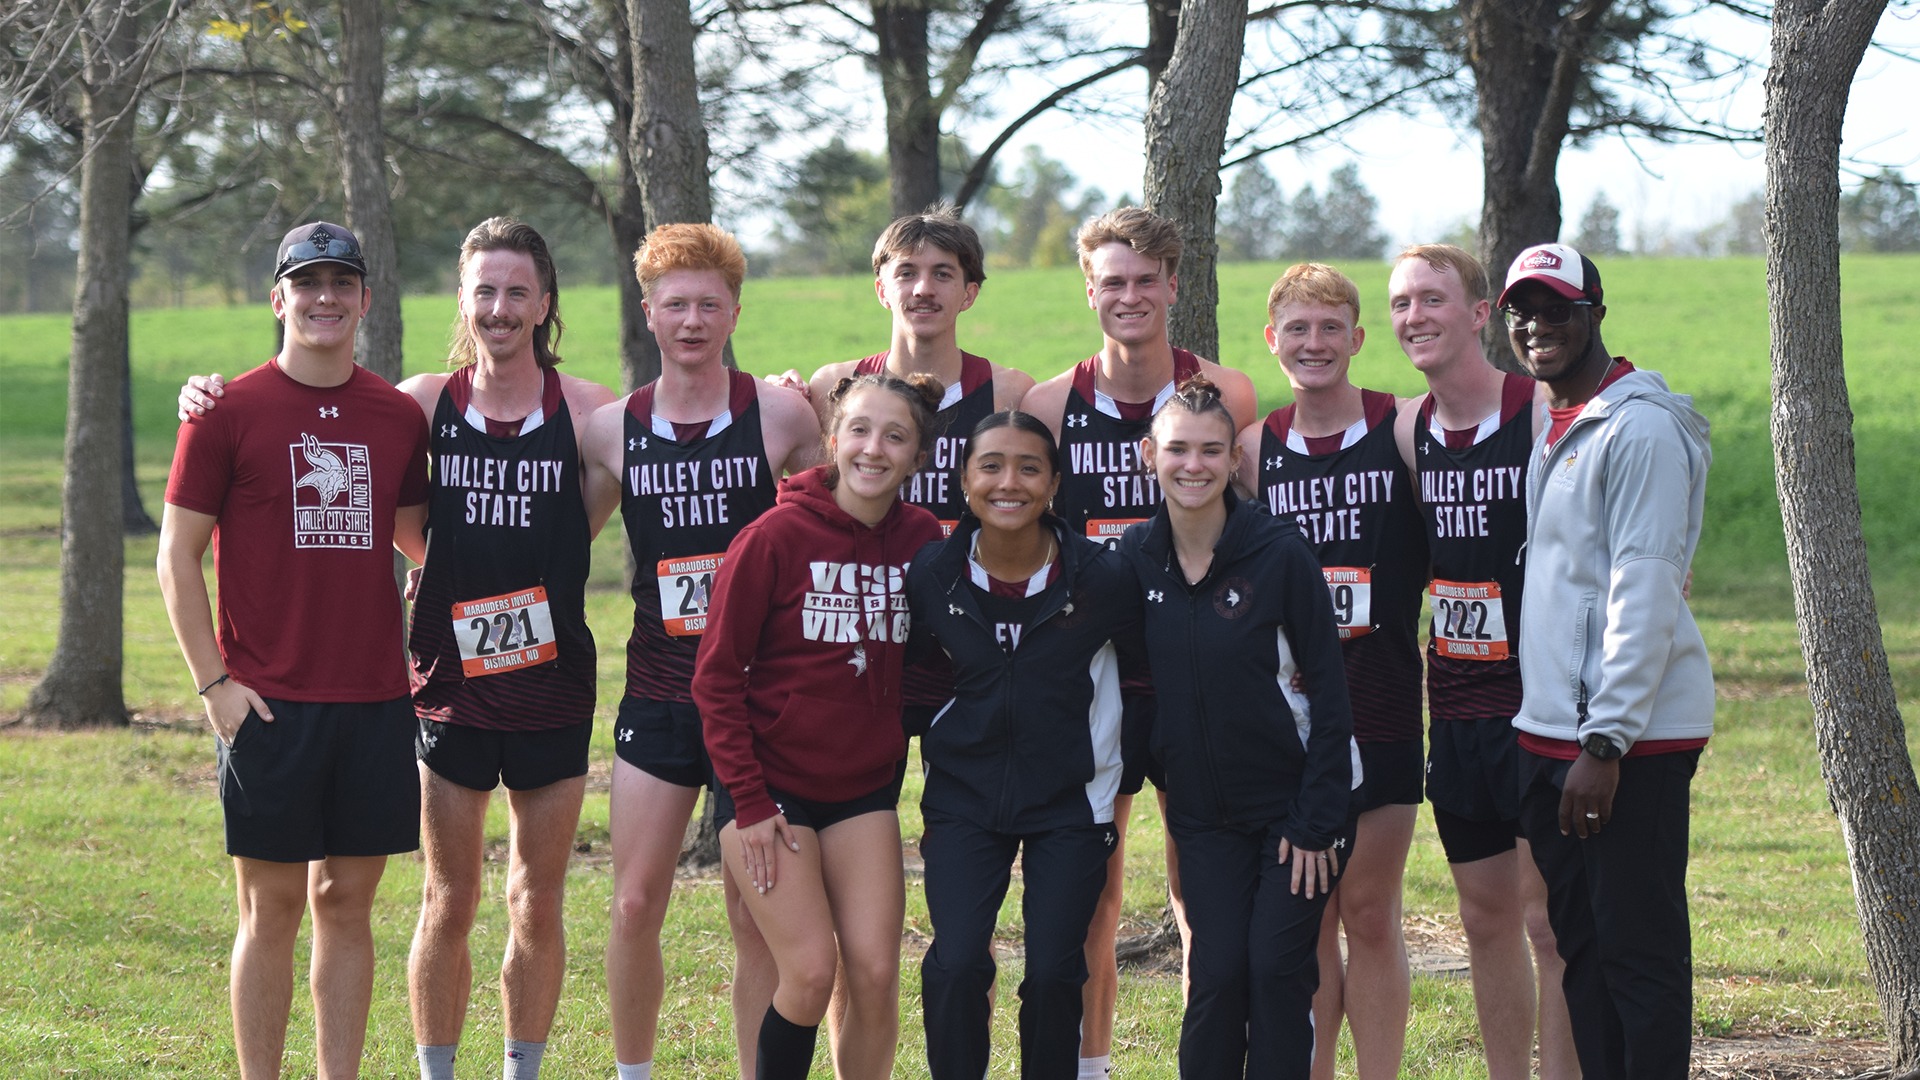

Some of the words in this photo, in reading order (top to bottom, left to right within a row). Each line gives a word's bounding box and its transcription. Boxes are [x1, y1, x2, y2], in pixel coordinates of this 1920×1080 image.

[350, 449, 366, 464] WE
[352, 465, 367, 481] ALL
[440, 454, 508, 490] VALLEY
[517, 460, 563, 492] CITY
[629, 461, 701, 496] VALLEY
[711, 457, 758, 490] CITY
[1103, 473, 1165, 508] STAT
[1267, 476, 1335, 516] VALLEY
[1344, 470, 1394, 505] CITY
[1473, 467, 1521, 502] CITY
[353, 486, 368, 507] ROW
[465, 491, 531, 527] STATE
[661, 493, 729, 528] STATE
[298, 511, 325, 531] VALLEY
[326, 511, 345, 531] CITY
[345, 511, 369, 532] STATE
[1295, 508, 1361, 544] STATE
[1436, 505, 1488, 538] STATE
[299, 535, 369, 545] VIKINGS
[668, 558, 717, 574] MARAUDERS
[809, 562, 911, 595] VCS
[1333, 571, 1359, 582] INVITE
[463, 599, 510, 617] MARAUDERS
[510, 592, 536, 608] INVITE
[870, 599, 880, 608] &
[1439, 598, 1492, 640] 222
[470, 607, 540, 656] 221
[483, 653, 526, 670] BISMARK,
[526, 649, 539, 662] ND
